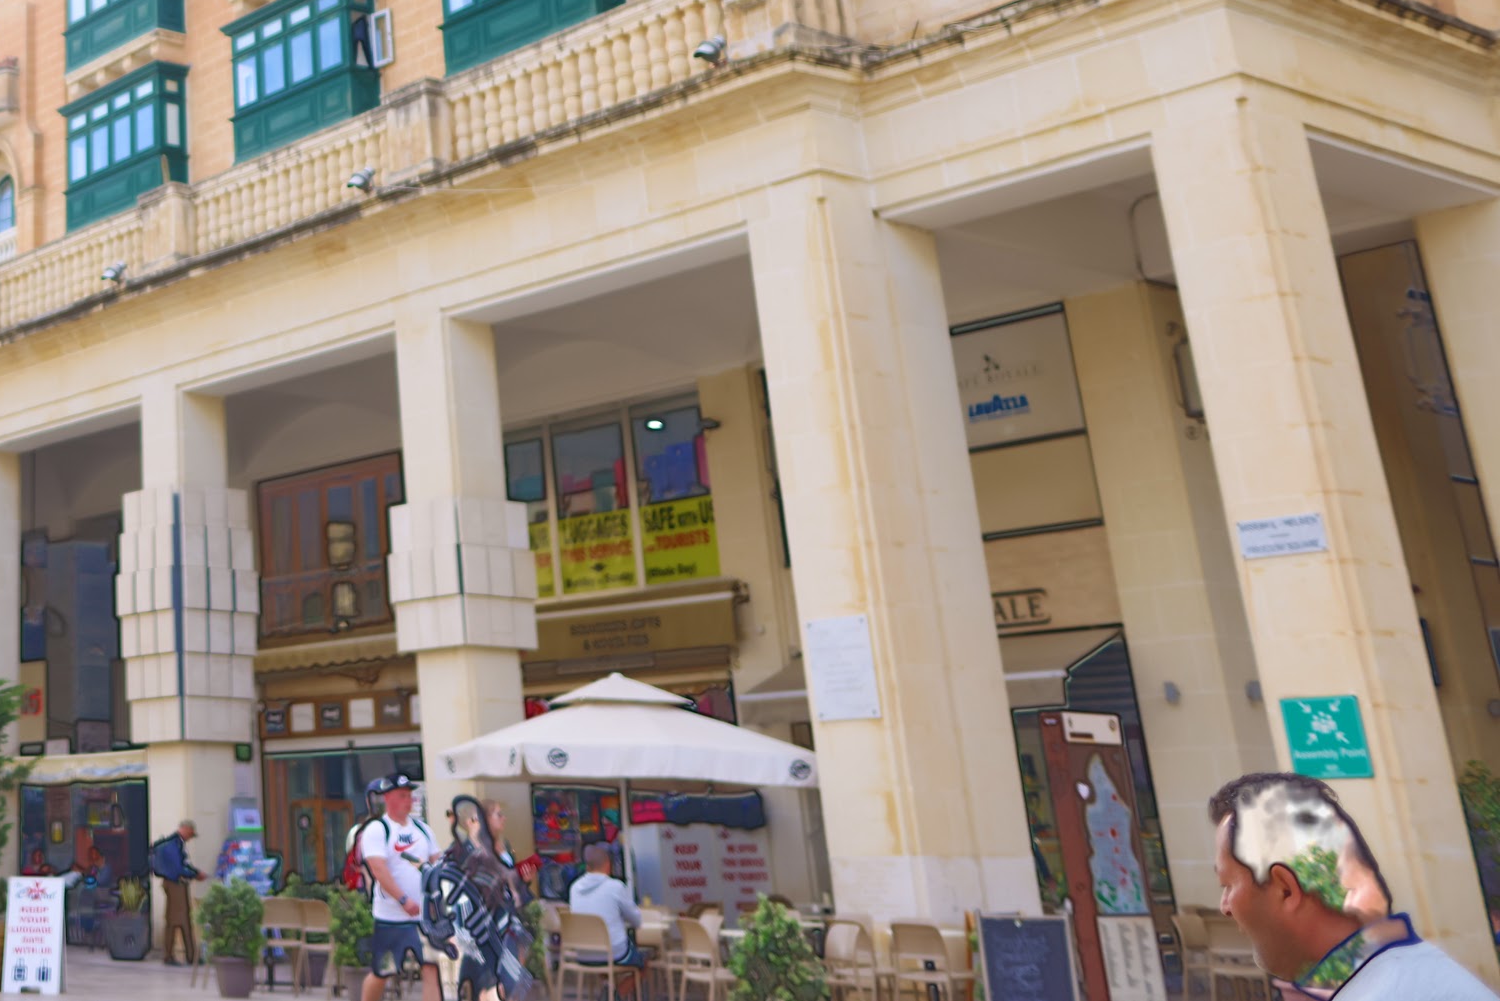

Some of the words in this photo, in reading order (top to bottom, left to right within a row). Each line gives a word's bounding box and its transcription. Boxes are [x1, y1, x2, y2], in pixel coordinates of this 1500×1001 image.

[968, 393, 1028, 417] LAVAZZA
[644, 506, 675, 532] SAFE
[1294, 749, 1339, 760] Assembly
[1340, 747, 1367, 757] Point
[674, 844, 698, 855] KEEP
[675, 860, 702, 870] YOUR
[668, 876, 707, 888] LUGGAGE
